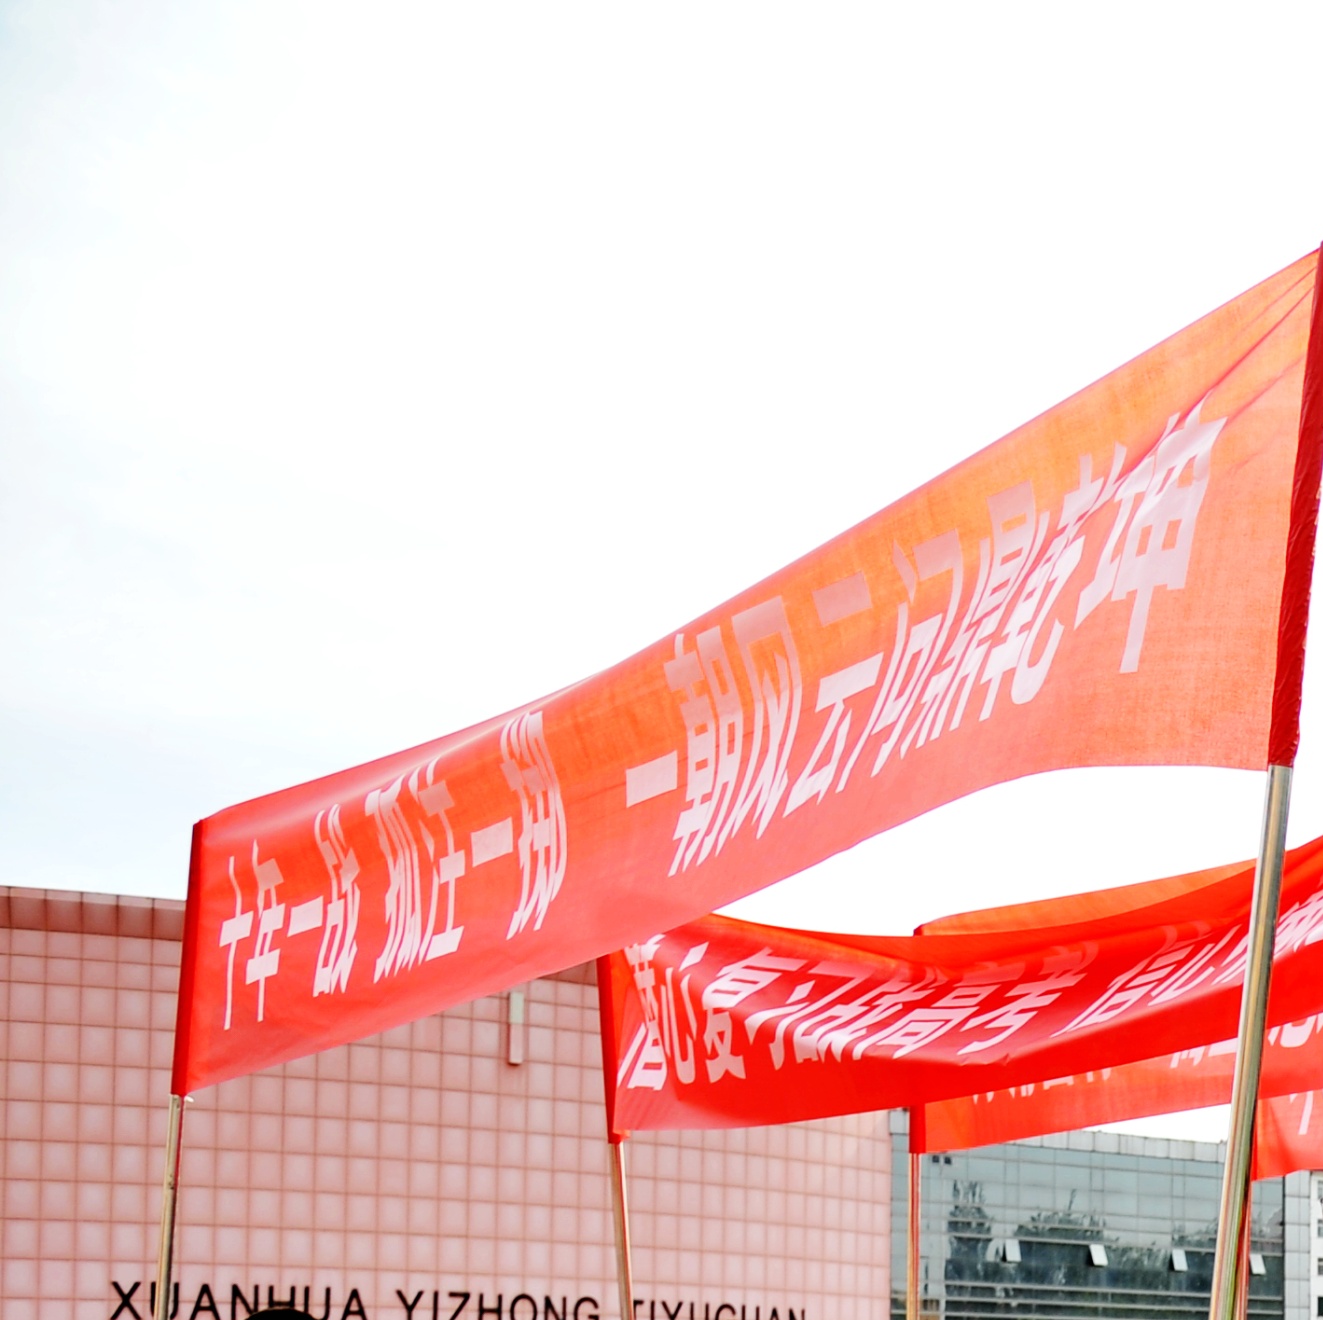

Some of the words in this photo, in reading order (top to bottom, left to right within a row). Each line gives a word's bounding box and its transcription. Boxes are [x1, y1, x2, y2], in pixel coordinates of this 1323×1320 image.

[218, 802, 360, 1031] 十年一战
[375, 711, 569, 985] 孤注一掷
[625, 391, 1229, 878] 一朝风云问鼎乾坤
